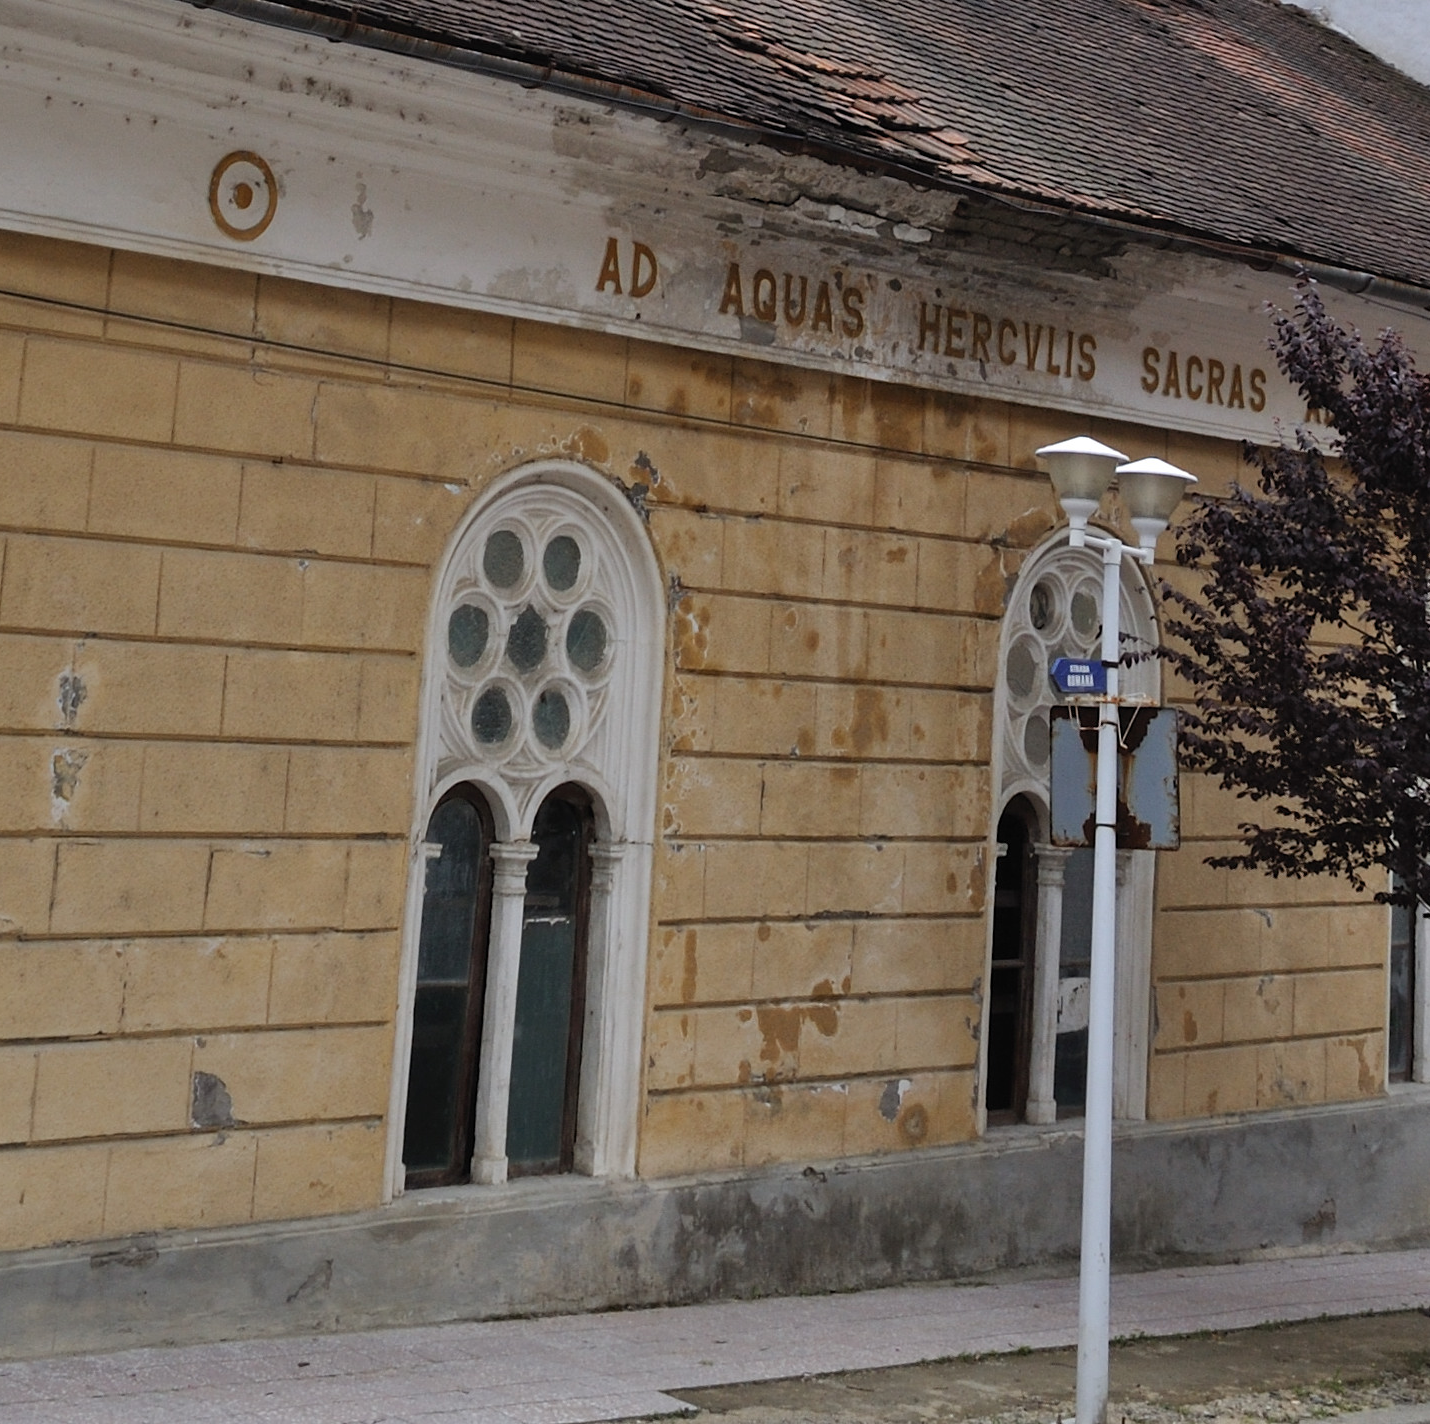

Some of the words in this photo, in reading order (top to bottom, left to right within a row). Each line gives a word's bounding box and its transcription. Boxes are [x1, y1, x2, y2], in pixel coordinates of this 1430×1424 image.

[595, 236, 658, 298] AD
[718, 262, 865, 338] AQUAS
[918, 301, 1098, 381] HERCVLIS
[1140, 347, 1267, 413] SACRAS
